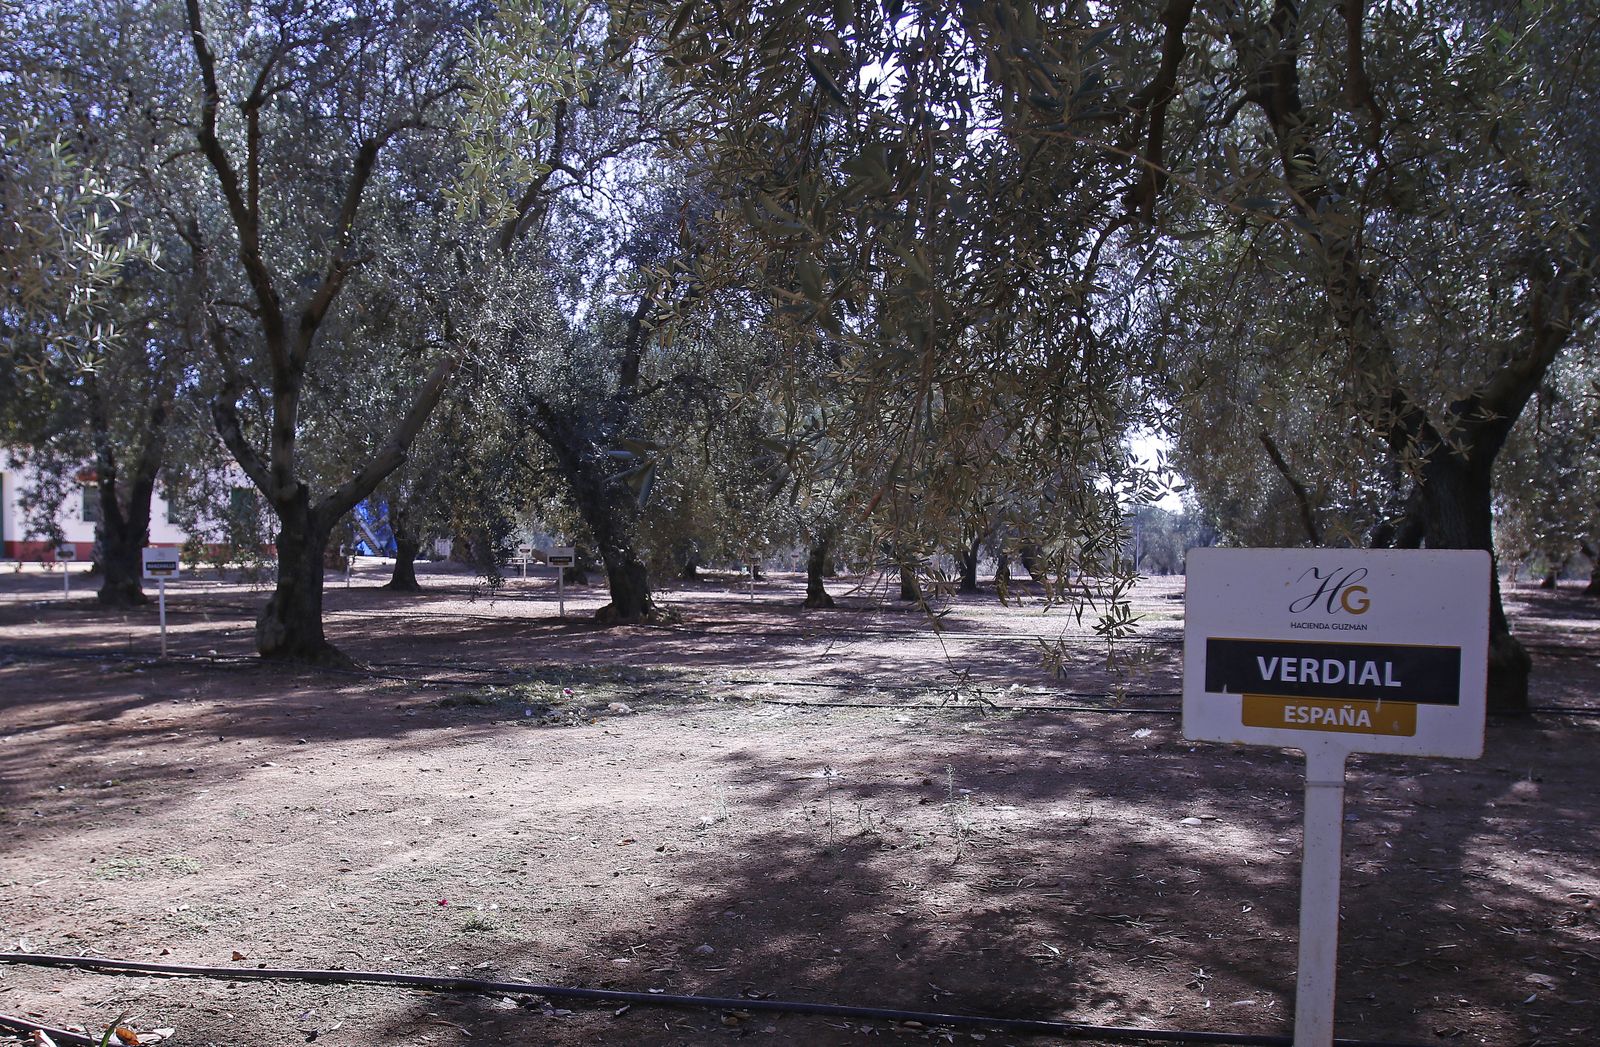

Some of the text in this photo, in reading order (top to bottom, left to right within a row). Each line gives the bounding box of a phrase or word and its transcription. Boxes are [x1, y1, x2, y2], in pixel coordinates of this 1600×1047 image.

[1289, 567, 1370, 614] HG
[1290, 622, 1331, 630] HACIENDA
[1256, 656, 1402, 687] VERDIAL
[1283, 705, 1372, 728] ESPAÑA
